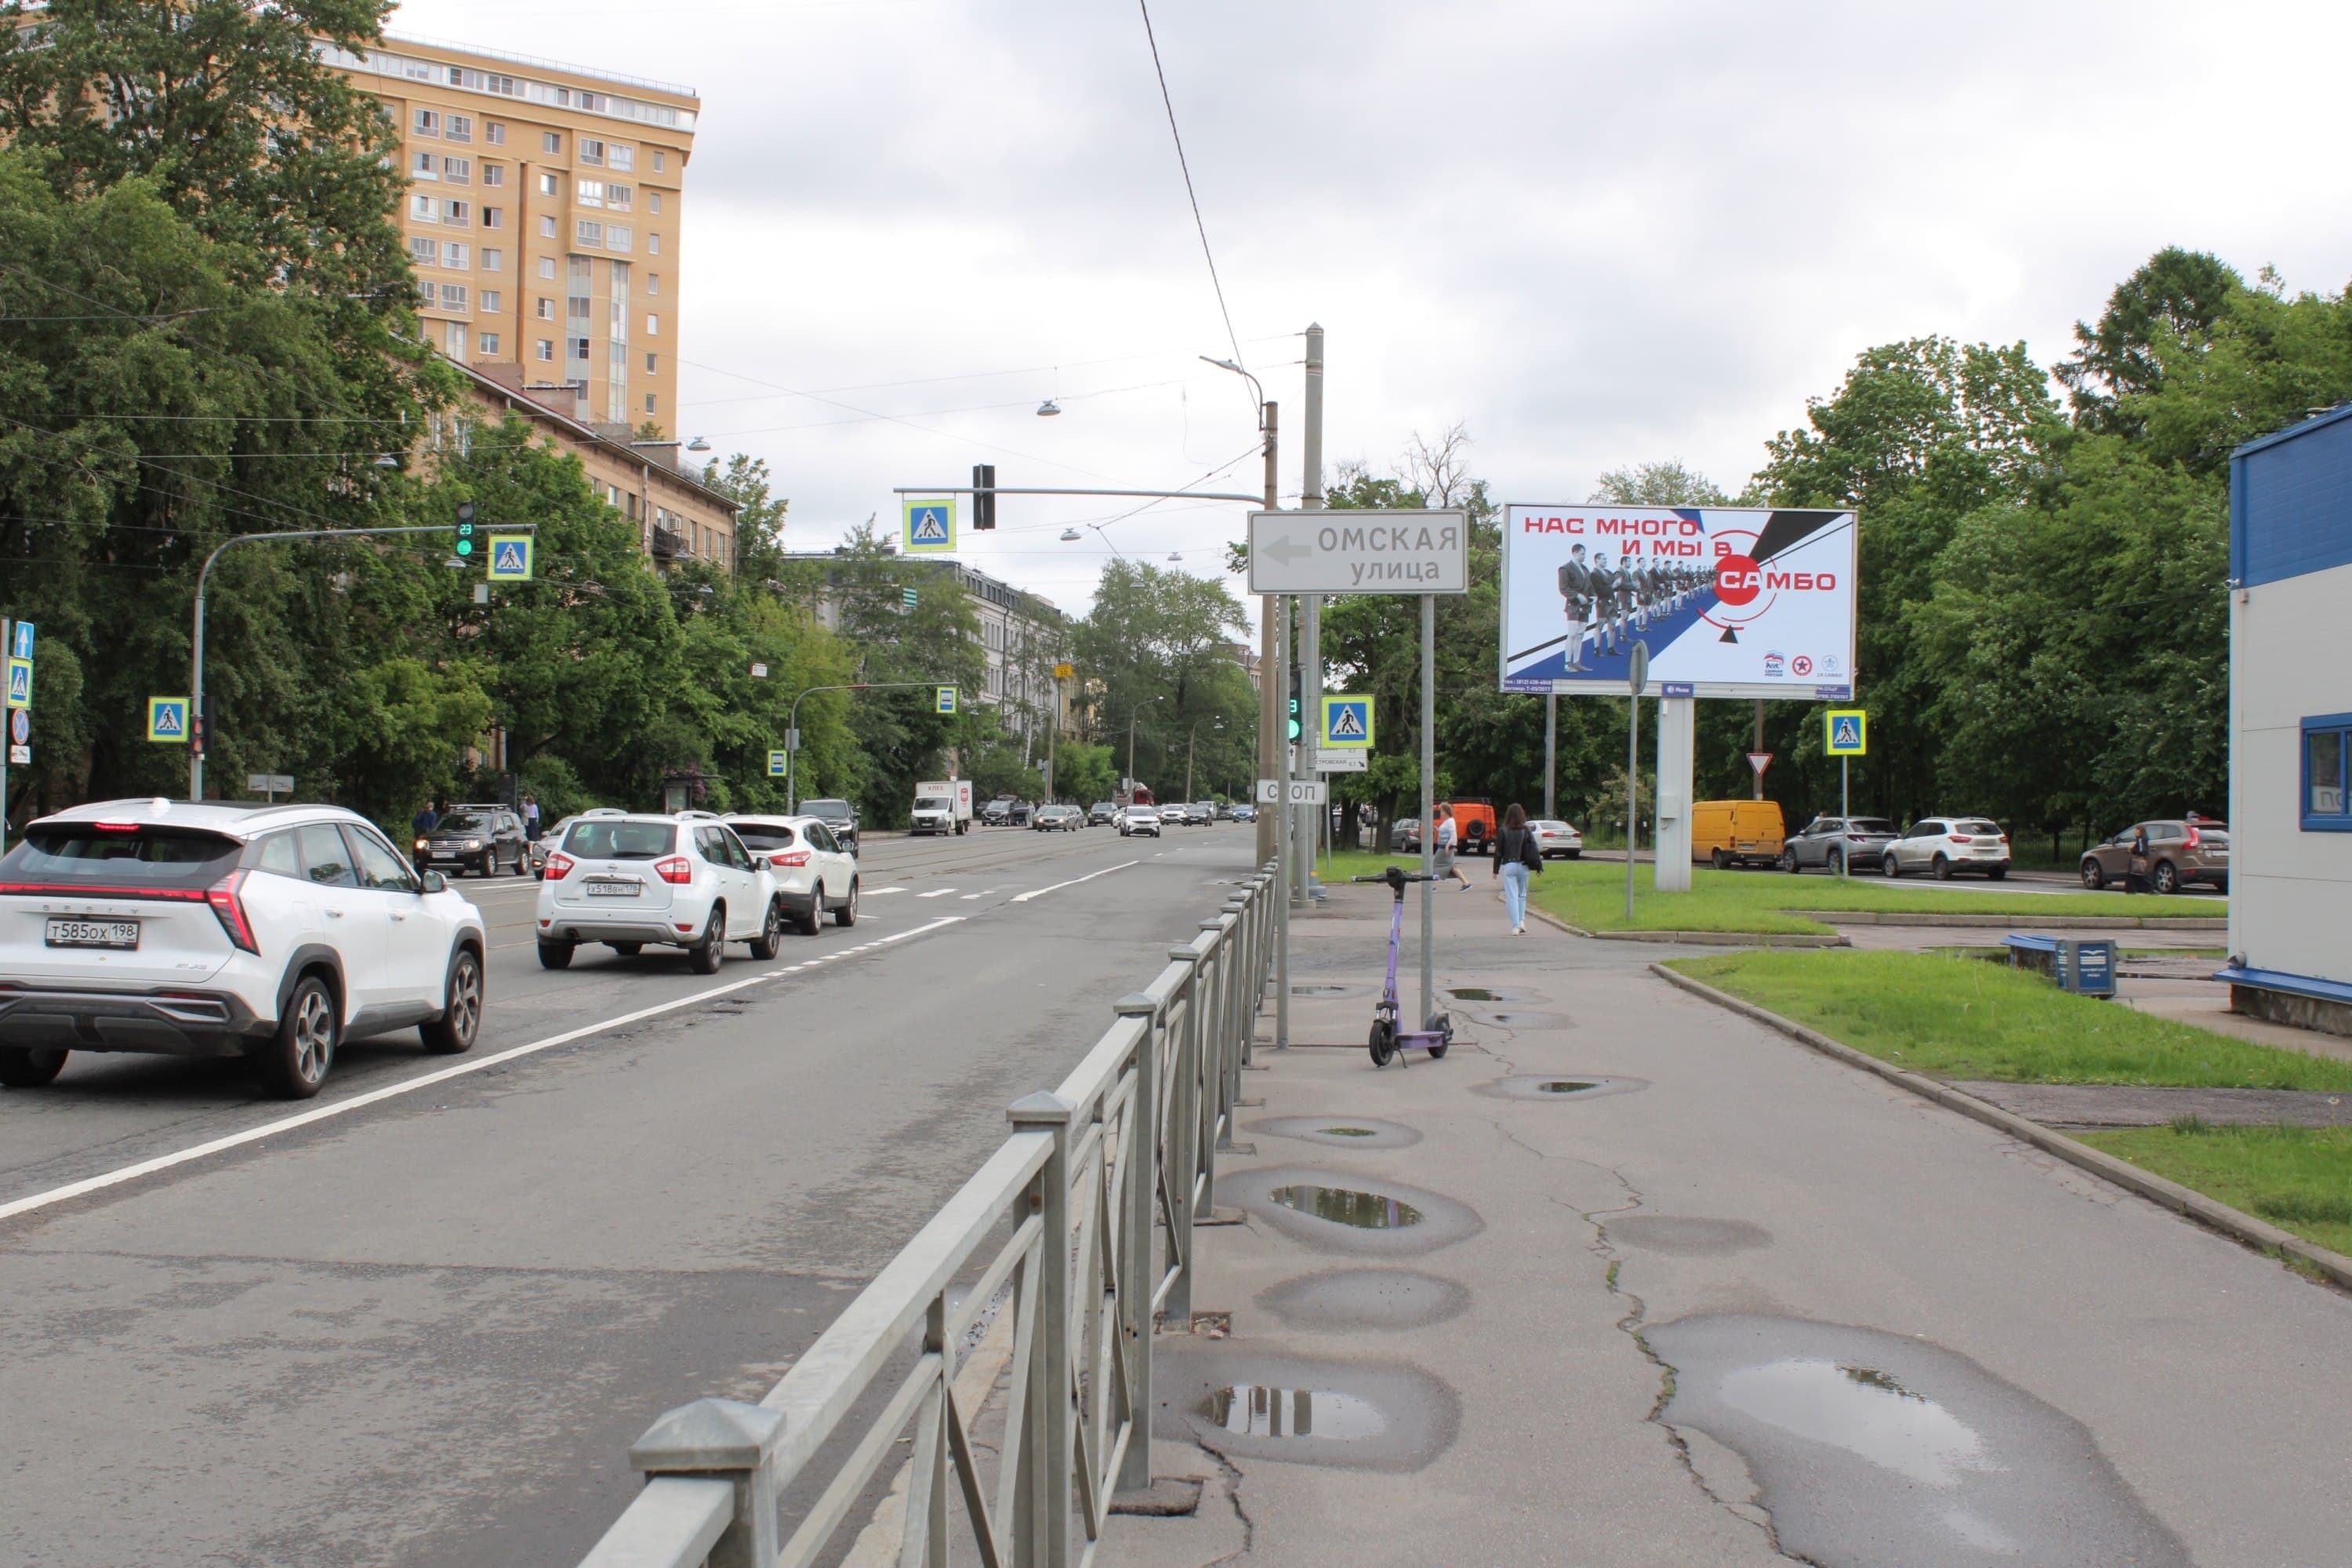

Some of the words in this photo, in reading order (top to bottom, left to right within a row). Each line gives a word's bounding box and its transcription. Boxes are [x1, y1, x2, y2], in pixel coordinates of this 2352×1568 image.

[459, 524, 471, 535] 23
[1525, 517, 1584, 534] НАС
[1596, 518, 1699, 536] МНОГО
[1318, 526, 1457, 552] ОМСКАЯ
[1622, 539, 1641, 554] И
[1653, 540, 1702, 556] МЫ
[1714, 541, 1733, 557] В
[1350, 561, 1440, 586] улица
[1720, 571, 1836, 591] САМБО
[1290, 699, 1298, 713] 3
[1267, 784, 1316, 800] СОП
[52, 922, 108, 940] Т585ОХ
[111, 924, 134, 937] 198
